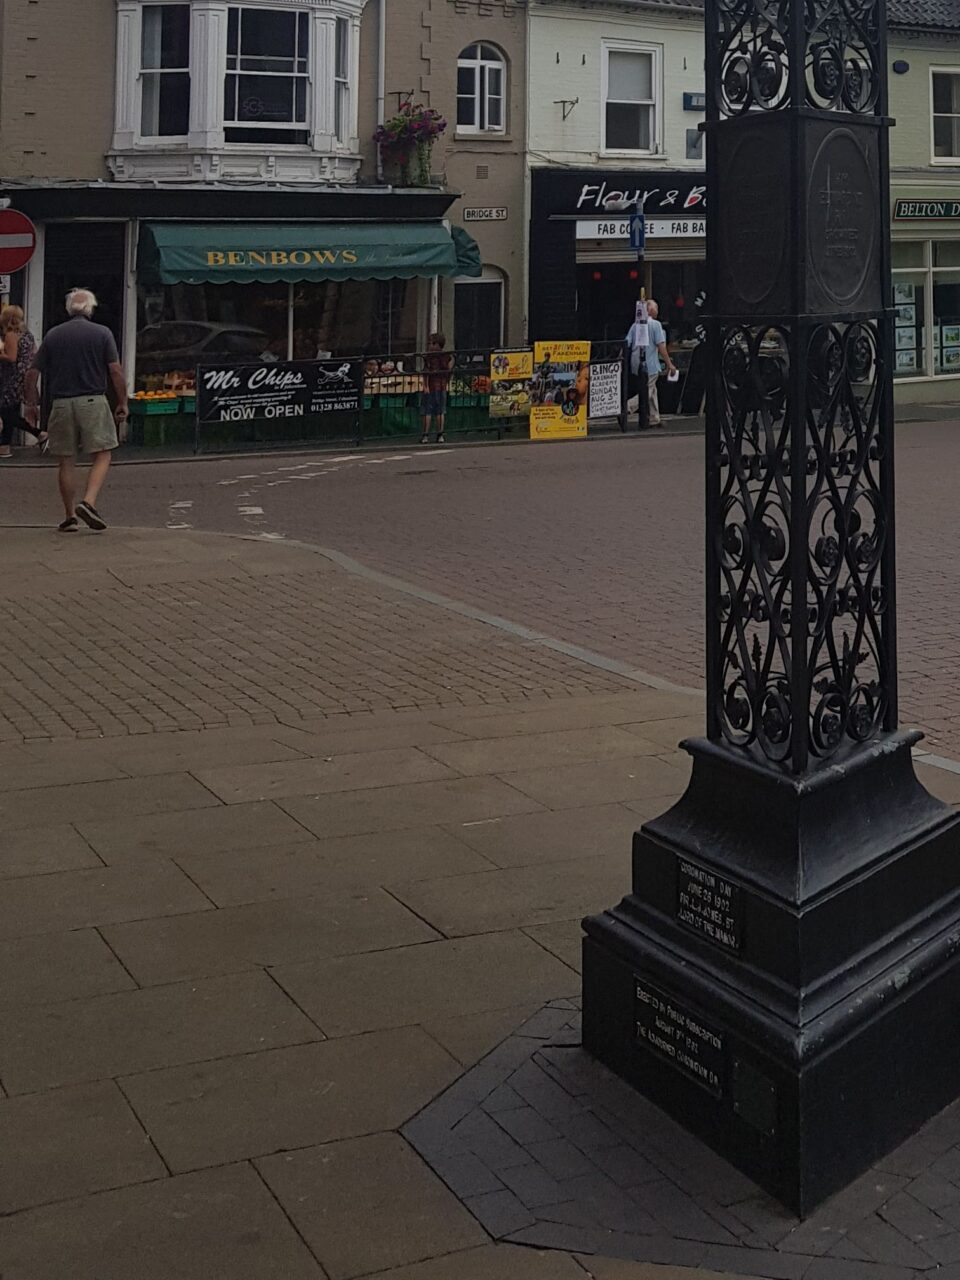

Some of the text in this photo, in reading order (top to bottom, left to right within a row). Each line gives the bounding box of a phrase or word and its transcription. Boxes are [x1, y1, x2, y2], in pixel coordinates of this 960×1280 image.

[466, 209, 494, 219] BRIDGE
[899, 202, 946, 217] BELTON
[598, 222, 617, 236] FAB
[619, 222, 655, 236] COEE
[671, 222, 689, 234] FAB
[207, 249, 358, 266] BENBOWS
[592, 363, 620, 376] BINGO
[203, 367, 305, 390] Mr Chips
[591, 385, 618, 396] SUNDAY
[220, 407, 256, 421] NOW
[264, 404, 304, 418] OPEN
